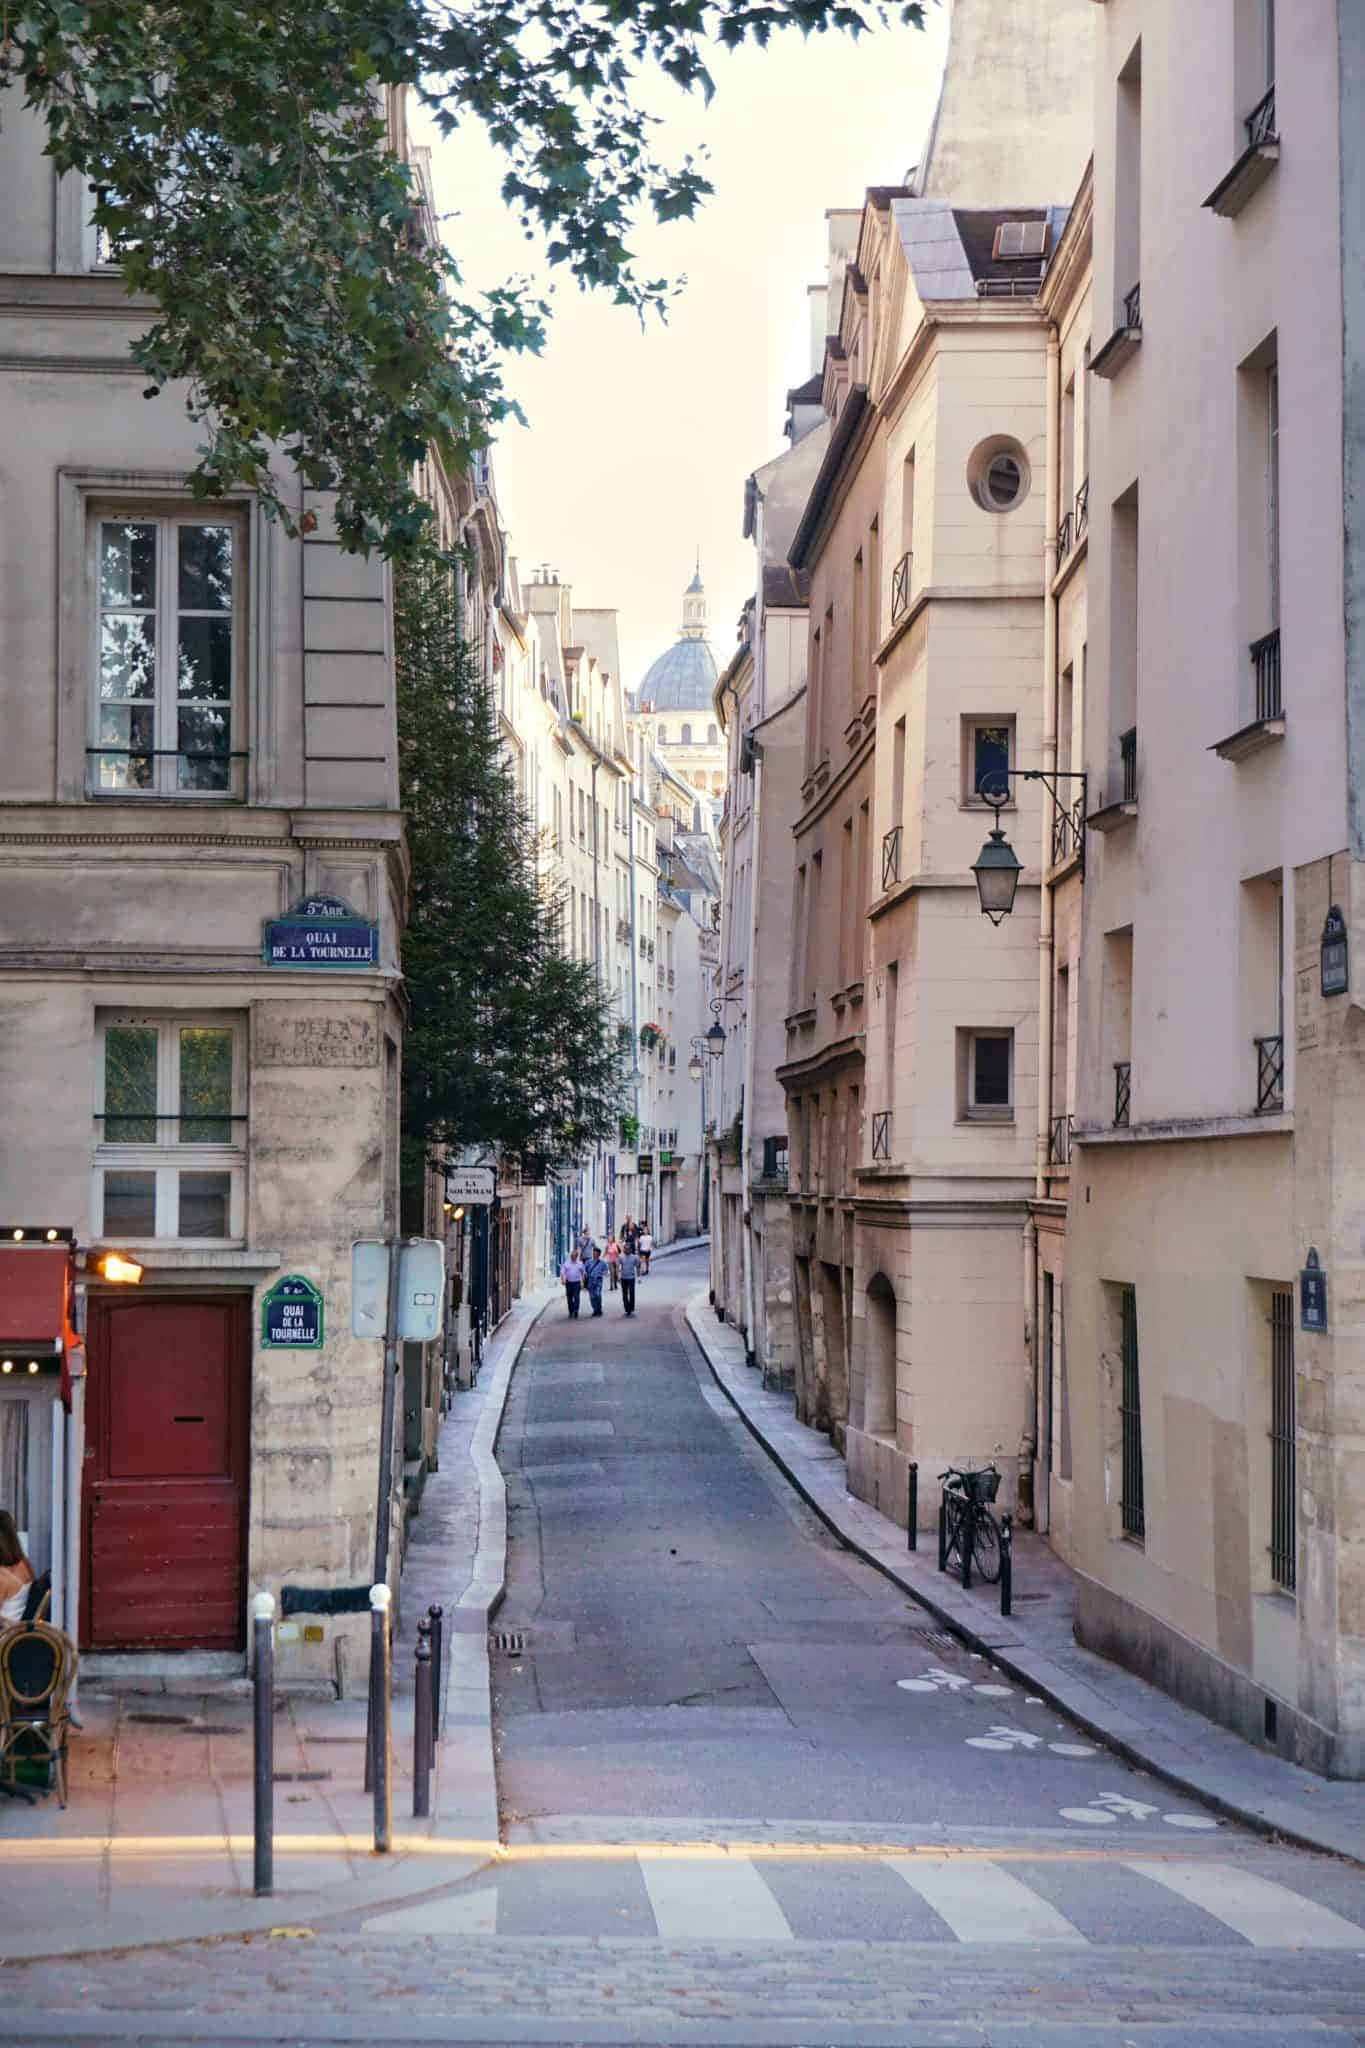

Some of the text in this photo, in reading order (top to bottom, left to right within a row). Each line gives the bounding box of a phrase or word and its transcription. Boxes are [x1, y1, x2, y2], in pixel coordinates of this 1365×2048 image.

[306, 932, 337, 944] QUAI
[272, 946, 372, 959] DE LA TOURNELLE
[283, 1305, 304, 1317] QUAI
[282, 1317, 304, 1327] DE LA
[271, 1328, 315, 1340] TOURNELLE
